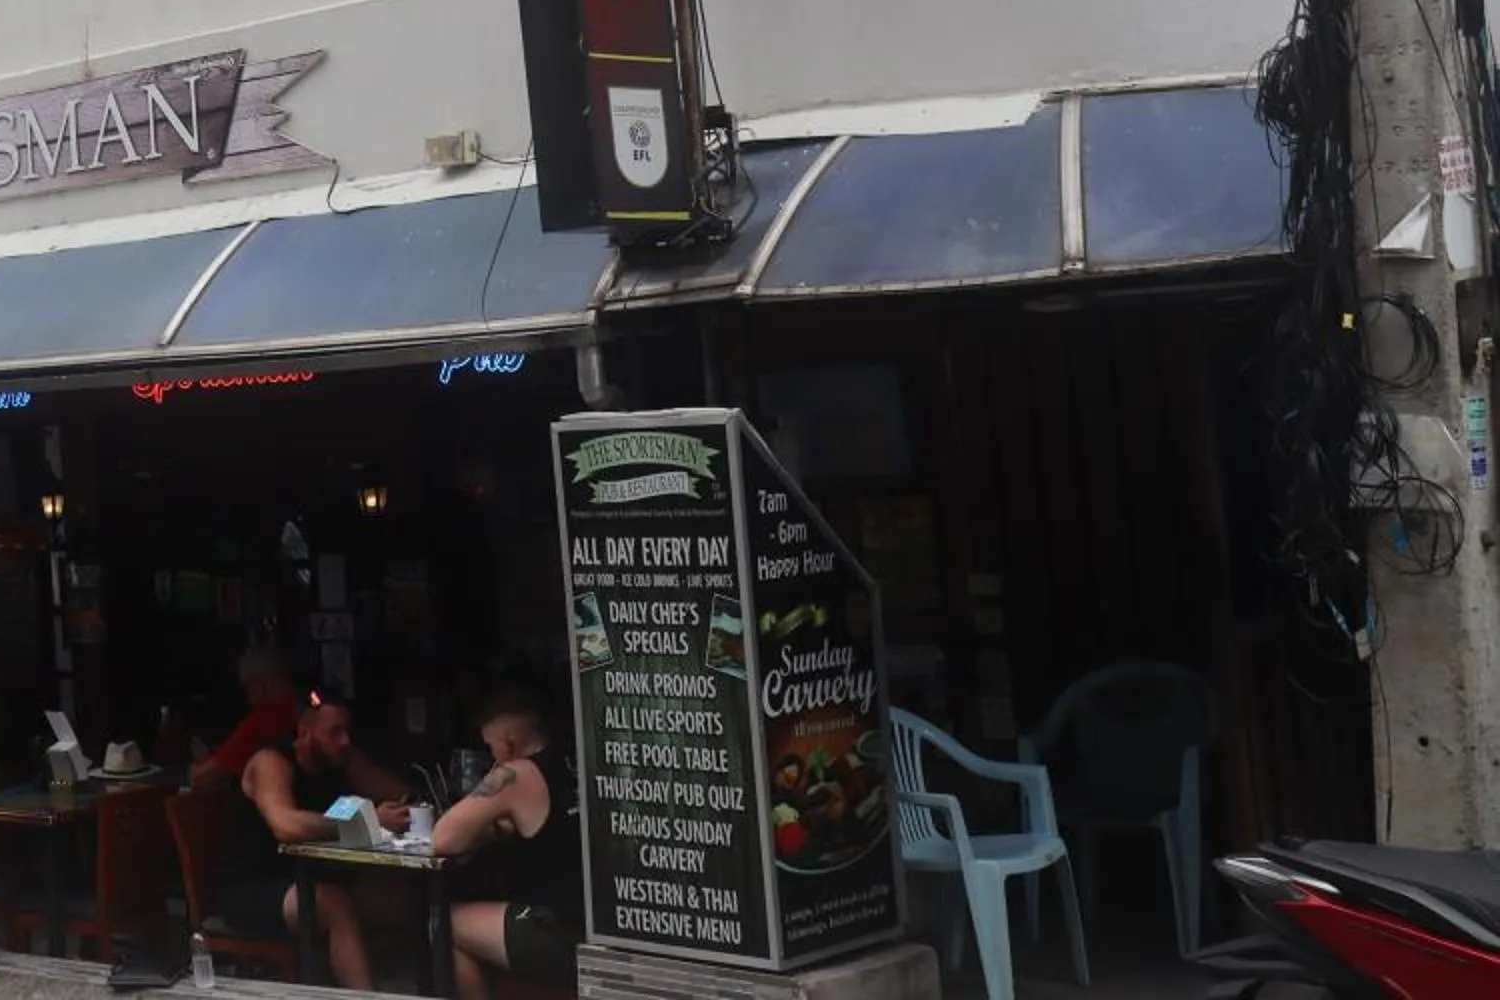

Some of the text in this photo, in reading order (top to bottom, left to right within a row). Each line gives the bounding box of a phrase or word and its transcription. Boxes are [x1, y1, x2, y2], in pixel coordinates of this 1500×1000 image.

[586, 434, 701, 468] THE SPORTSMAN
[627, 473, 685, 497] RESTAURANT
[757, 489, 788, 514] 7am
[778, 520, 807, 545] 6pm
[572, 536, 729, 567] ALL DAY EVERY DAY
[757, 549, 835, 581] Happy Hour
[609, 600, 699, 626] DAILY CHEF'S
[623, 629, 689, 655] SPECIALS
[780, 637, 853, 677] Sunday
[605, 671, 717, 698] DRINK PROMOS
[762, 669, 875, 718] Carvery
[605, 705, 723, 735] ALL LIVE SPORTS
[605, 741, 729, 773] FREE POOL TABLE
[595, 775, 745, 811] THURSDAY PUB QUIZ
[611, 811, 733, 847] FAMOUS SUNDAY
[640, 844, 705, 873] CARVERY
[614, 876, 739, 914] WESTERN & THAI
[616, 906, 742, 945] EXTENSIVE MENU
